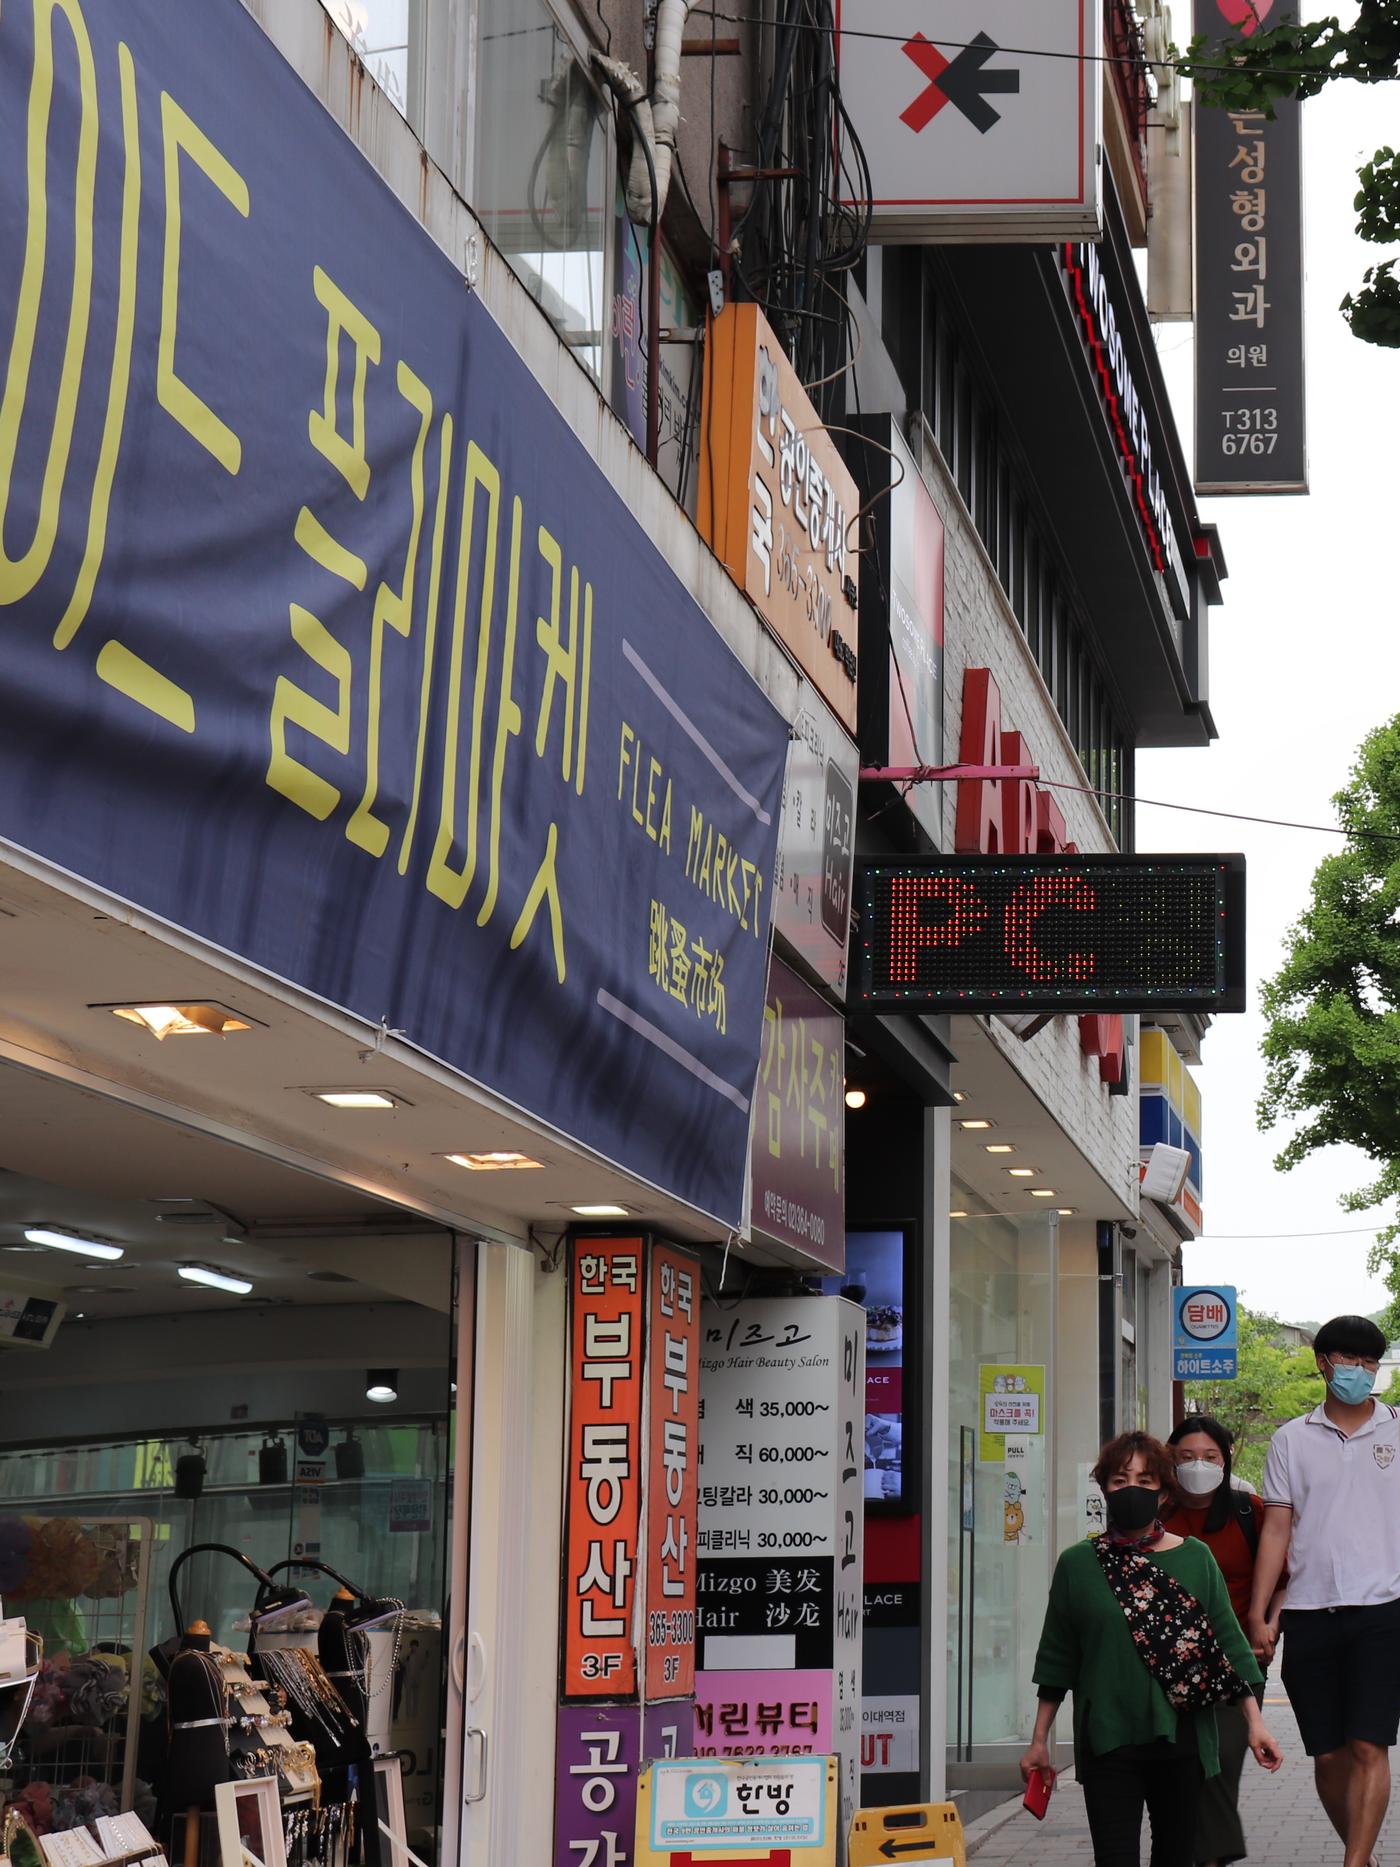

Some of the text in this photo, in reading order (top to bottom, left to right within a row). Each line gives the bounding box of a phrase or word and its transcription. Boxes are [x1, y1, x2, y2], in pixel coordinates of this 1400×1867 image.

[1225, 344, 1268, 369] 의원
[1221, 408, 1278, 431] T313
[1221, 433, 1278, 455] 6767
[265, 264, 593, 985] 플리마켓
[618, 721, 763, 938] FLEA MARKET
[824, 855, 846, 916] Hair
[649, 898, 727, 1036] 跳蚤市场
[579, 1254, 637, 1294] 한국
[660, 1262, 693, 1325] 한국
[1187, 1304, 1223, 1323] 담배
[727, 1357, 754, 1370] Hair
[756, 1356, 796, 1372] Beauty
[798, 1354, 830, 1368] Salon
[1177, 1359, 1234, 1375] 하이트소주
[661, 1329, 689, 1597] 부동산
[1007, 1446, 1025, 1454] PULL
[578, 1311, 633, 1640] 부동산
[766, 1569, 822, 1594] 美发
[649, 1609, 694, 1647] 365-3300
[766, 1603, 821, 1628] 沙龙
[837, 1593, 859, 1640] Hair
[581, 1653, 623, 1680] 3F
[664, 1655, 680, 1683] 3F
[862, 1709, 906, 1723] 이대역점
